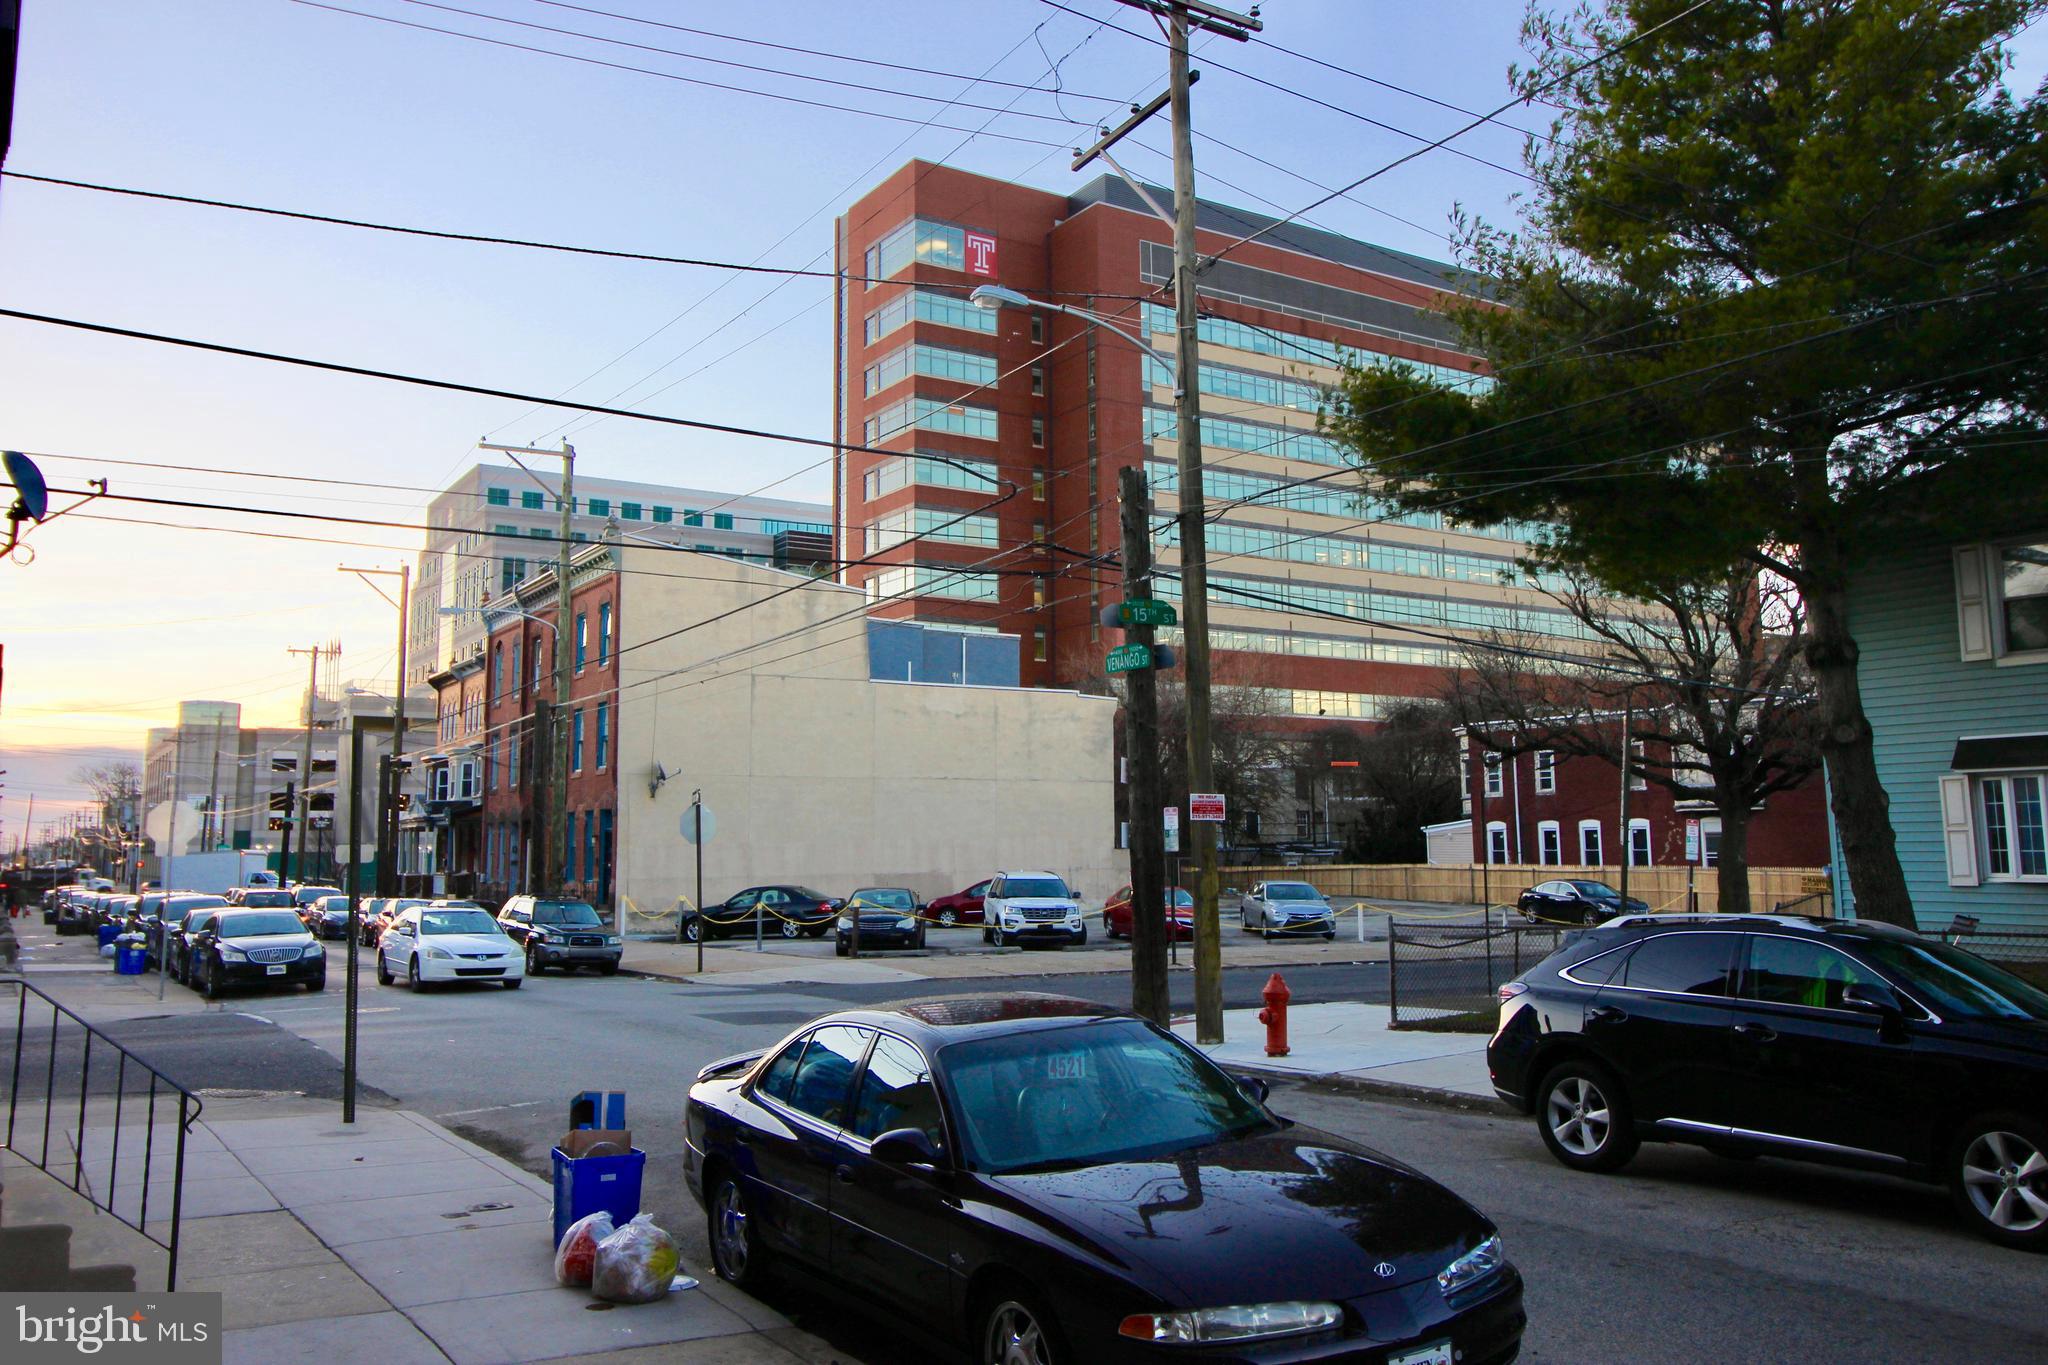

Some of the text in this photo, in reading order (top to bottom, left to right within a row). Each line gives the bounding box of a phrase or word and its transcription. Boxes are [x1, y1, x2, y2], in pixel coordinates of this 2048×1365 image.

[968, 235, 995, 274] T
[1132, 607, 1175, 623] 15TH ST
[1107, 652, 1149, 671] VENANGO ST
[1049, 1055, 1083, 1078] 4521
